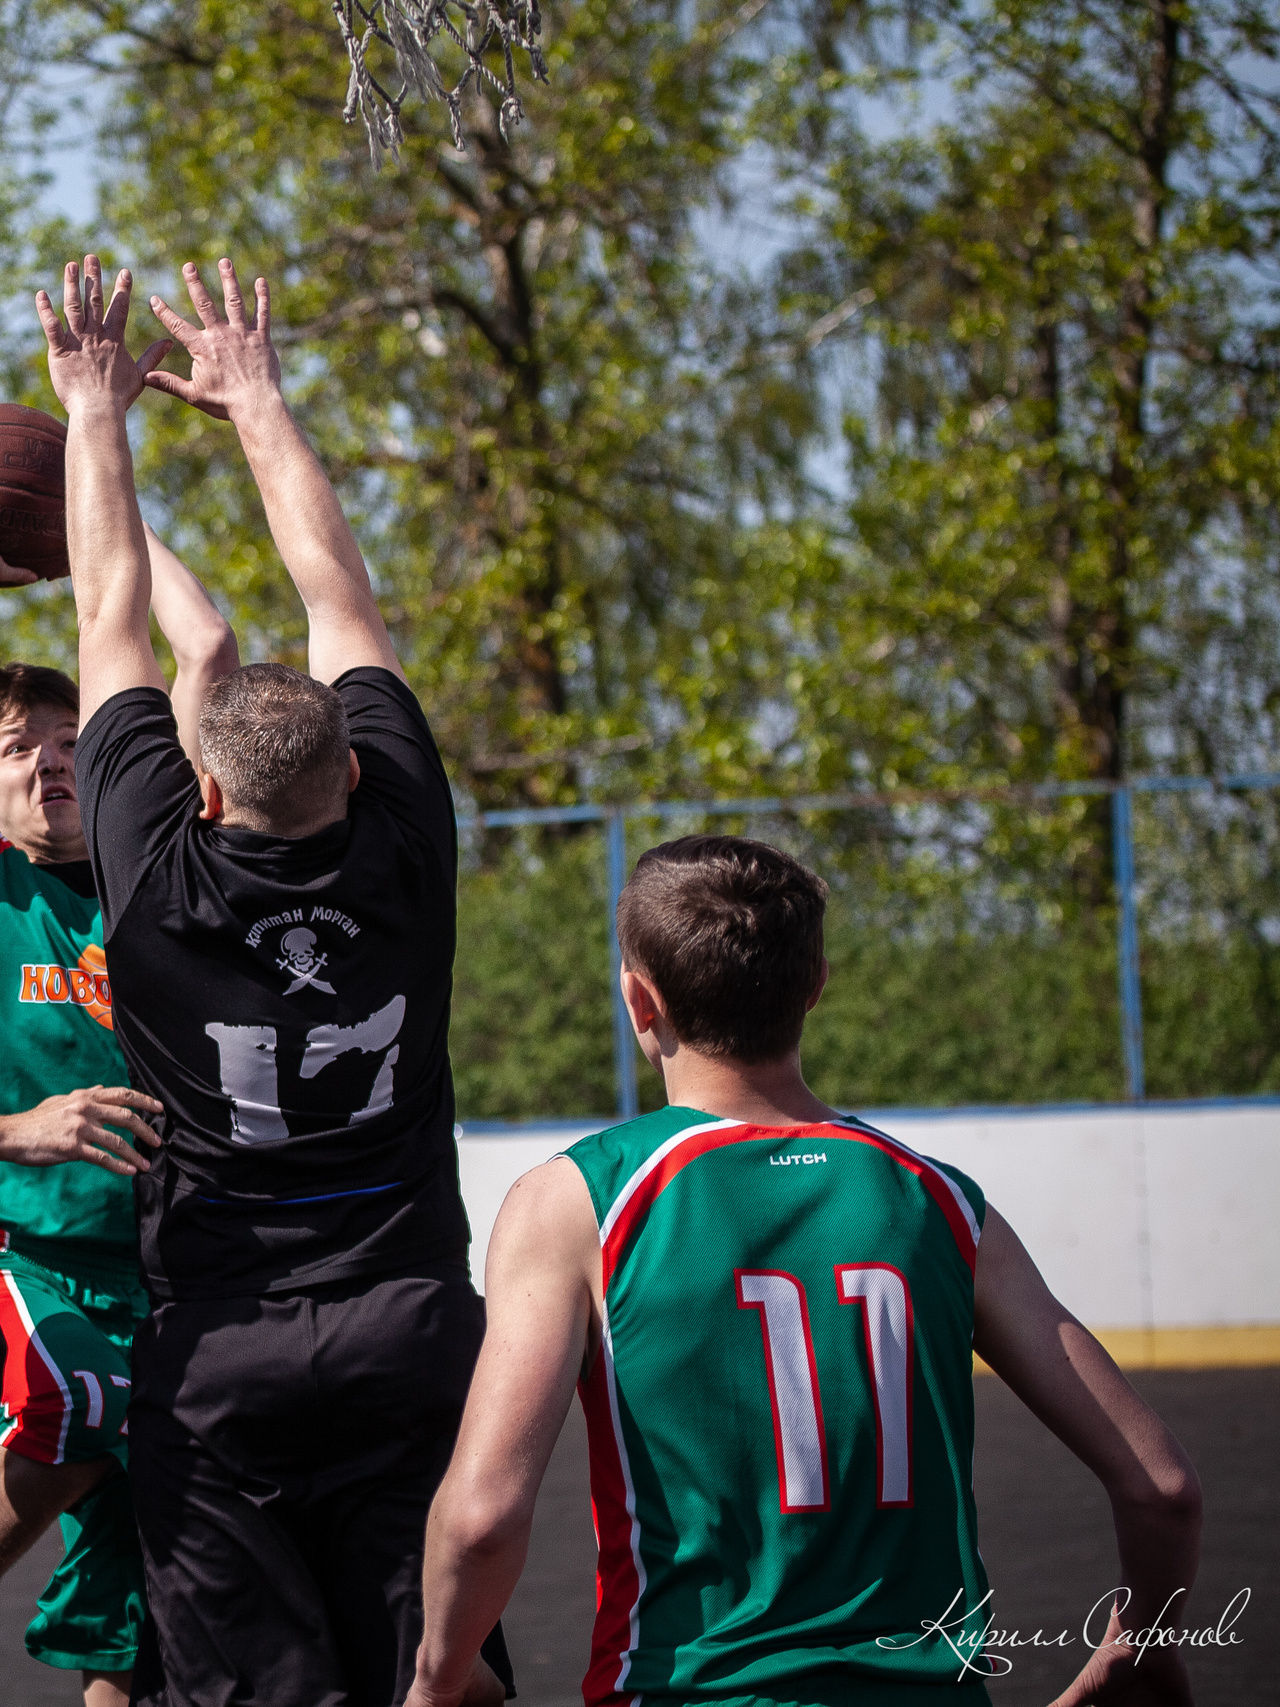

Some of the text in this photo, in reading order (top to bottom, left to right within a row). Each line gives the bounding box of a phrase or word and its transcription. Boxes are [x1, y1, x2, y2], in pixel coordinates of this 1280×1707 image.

[310, 905, 362, 939] Морган
[204, 994, 407, 1146] 17
[769, 1152, 827, 1166] LUTCH
[733, 1261, 915, 1515] 11
